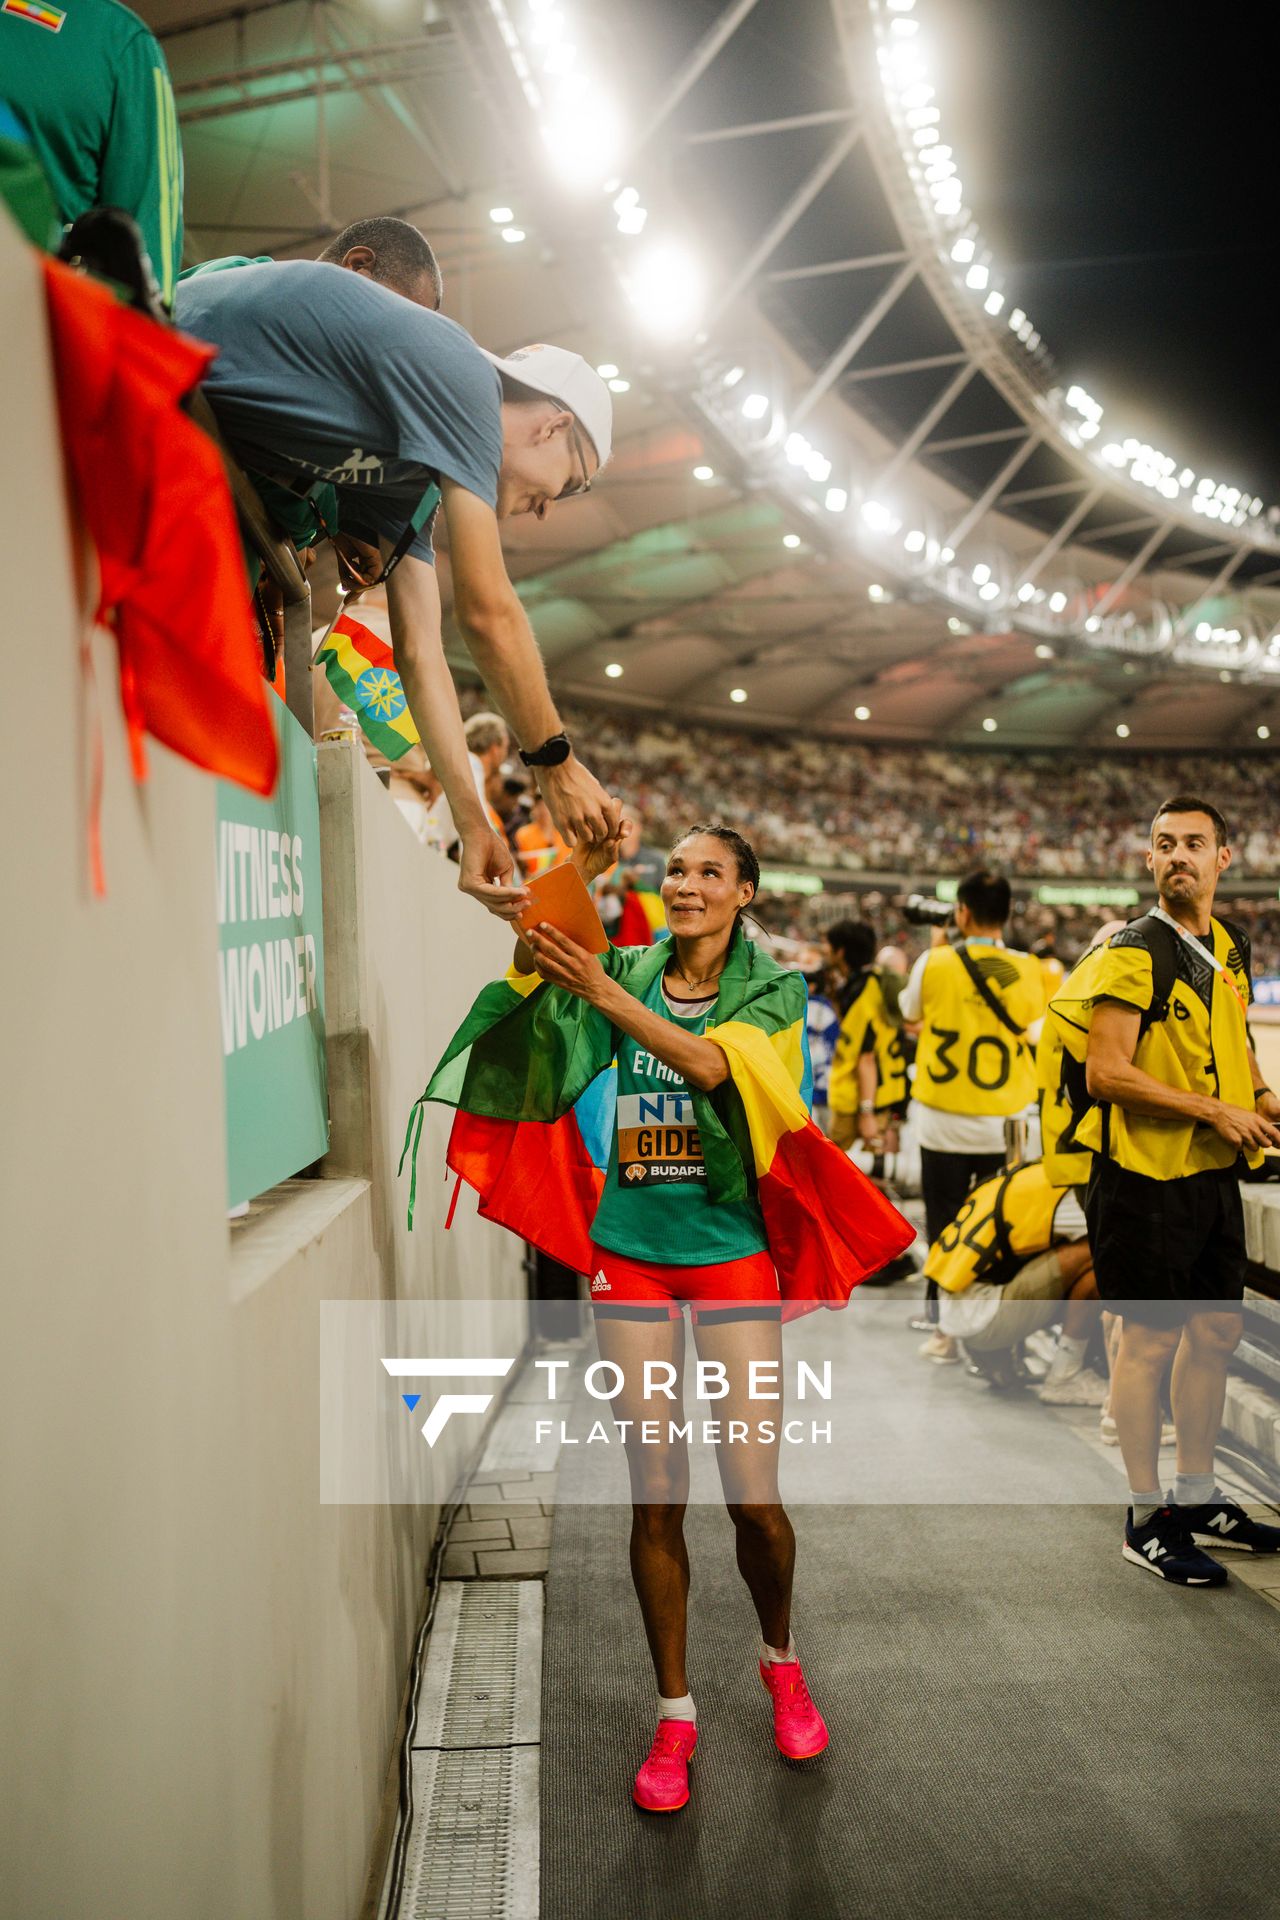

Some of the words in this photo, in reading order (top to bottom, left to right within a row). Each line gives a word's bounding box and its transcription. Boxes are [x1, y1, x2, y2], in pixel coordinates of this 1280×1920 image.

[217, 933, 318, 1057] WONDER
[927, 1024, 1011, 1091] 30
[637, 1128, 702, 1158] GIDE
[650, 1165, 707, 1177] BUDAPE
[1207, 1511, 1239, 1534] N
[1142, 1537, 1167, 1561] N
